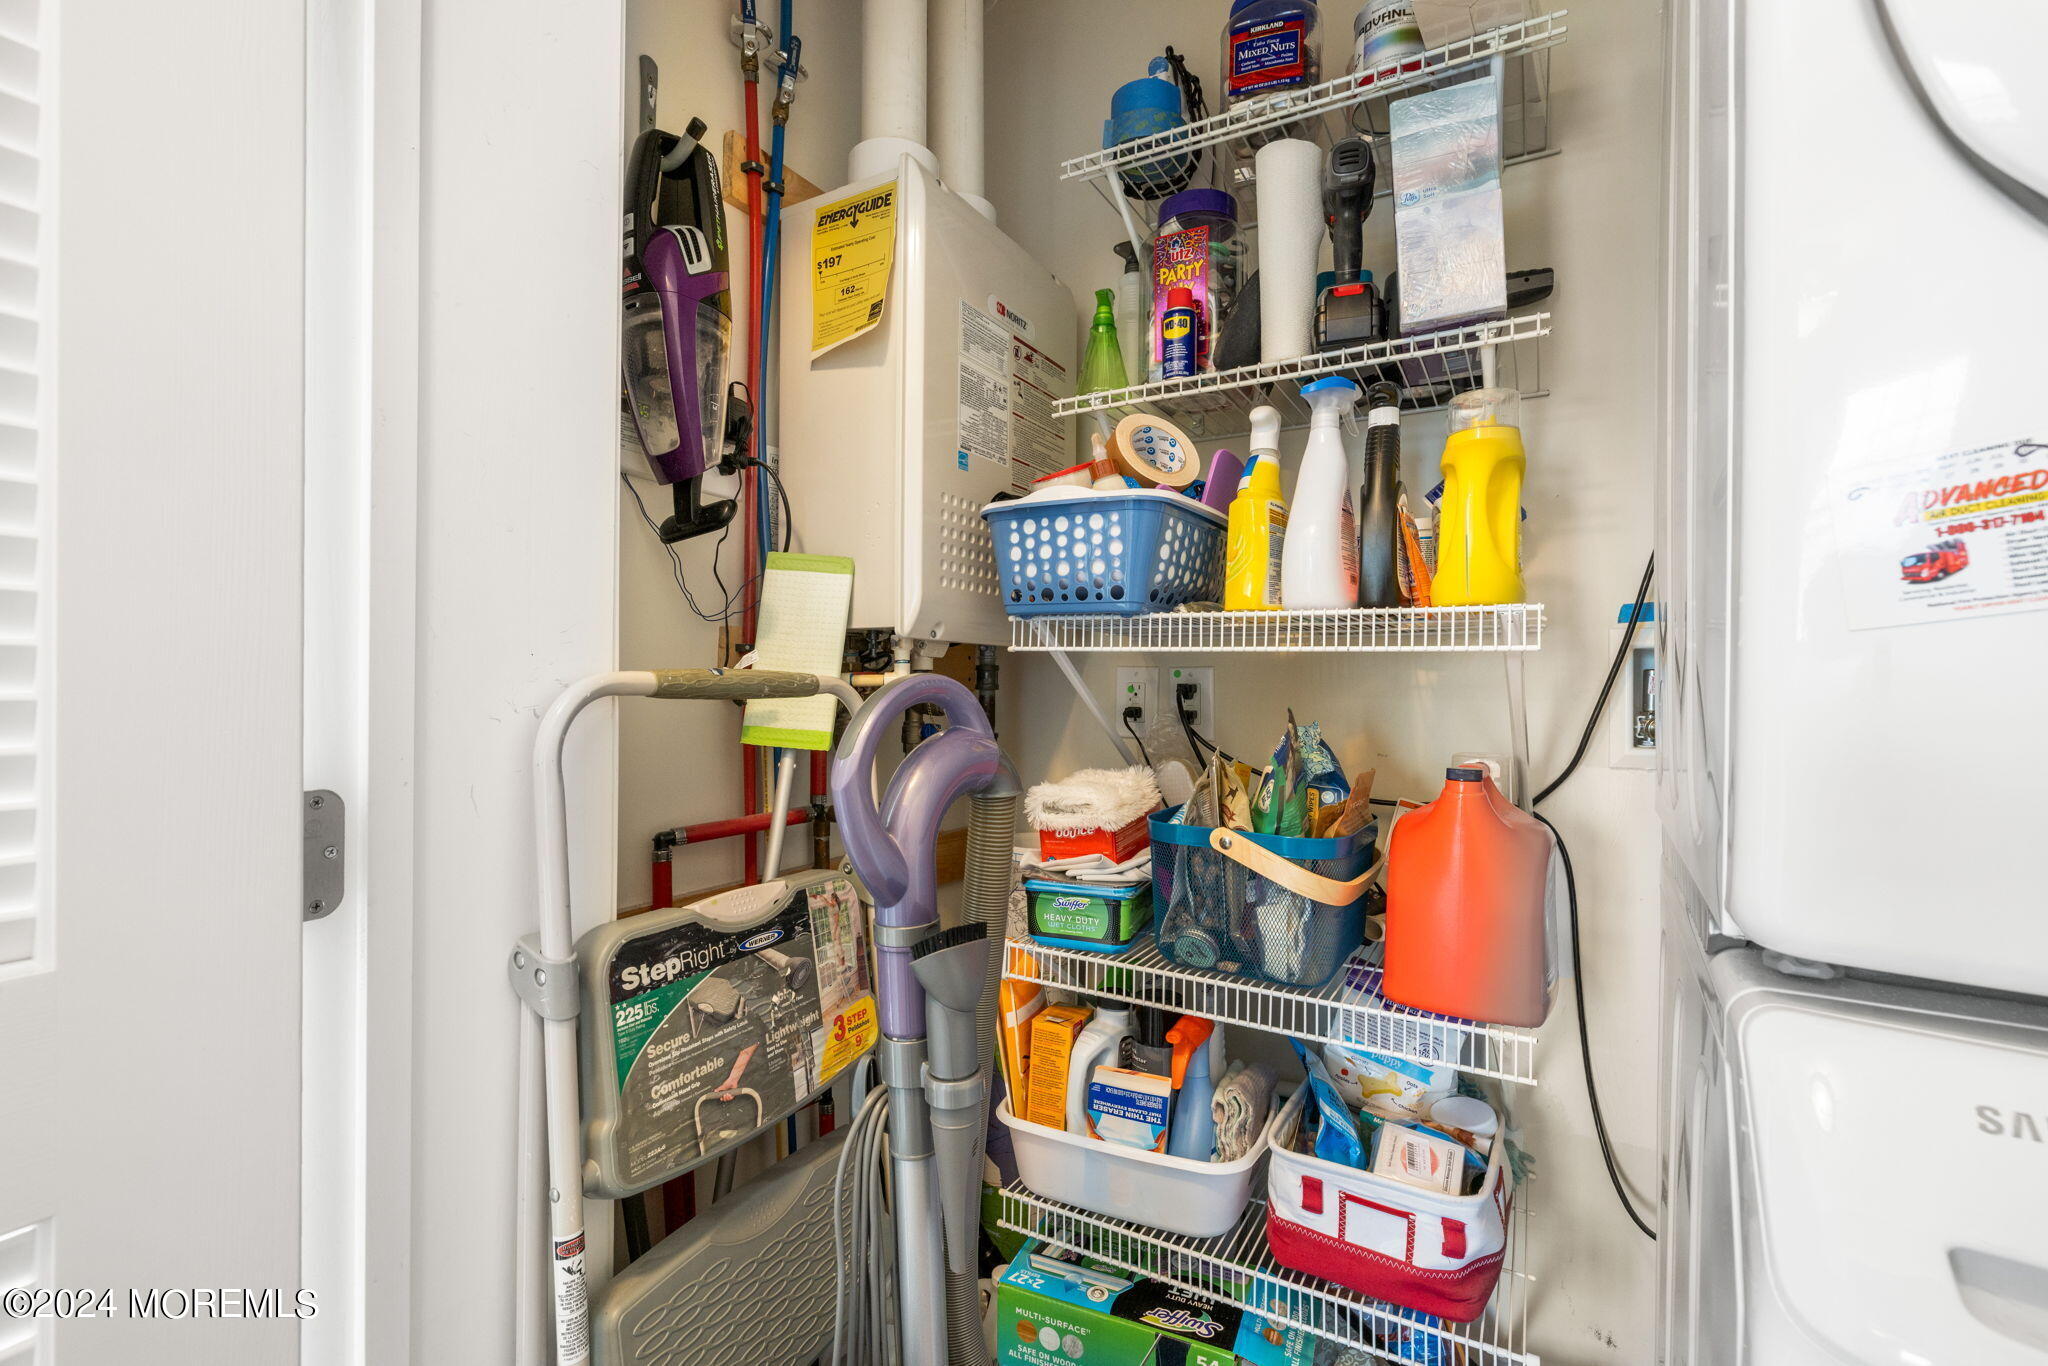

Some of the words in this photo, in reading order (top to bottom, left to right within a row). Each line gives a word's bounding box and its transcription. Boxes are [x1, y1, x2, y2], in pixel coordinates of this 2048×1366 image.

[1250, 21, 1284, 33] KIRKLAND
[1238, 47, 1269, 61] MIXED
[1270, 41, 1296, 53] NUTS
[817, 254, 842, 270] $197
[1160, 259, 1204, 285] PARTY
[840, 285, 856, 296] 162
[1006, 309, 1027, 330] NORITZ
[1053, 896, 1089, 911] Swiffer
[1044, 913, 1072, 922] HEAVY
[1075, 915, 1100, 926] DUTY
[1047, 921, 1065, 929] WET
[1066, 922, 1096, 932] CLOTHS
[748, 933, 776, 947] WERNER
[616, 1003, 644, 1028] 225
[846, 1008, 867, 1026] STEP
[765, 1009, 819, 1044] Lightwight
[833, 1014, 847, 1041] 3
[647, 1032, 690, 1059] Secure
[651, 1056, 725, 1100] Comfortable
[1093, 1103, 1124, 1116] ERASER
[1125, 1112, 1144, 1121] THIN
[1146, 1115, 1162, 1124] THE
[1165, 1293, 1187, 1303] DUTY
[1187, 1300, 1213, 1311] HEAVY
[1146, 1307, 1224, 1338] Swiffer
[1288, 1330, 1296, 1340] ON
[1008, 1348, 1022, 1360] ALL
[1018, 1344, 1037, 1356] SAFE
[1039, 1351, 1050, 1360] ON
[1285, 1340, 1295, 1358] SAFE
